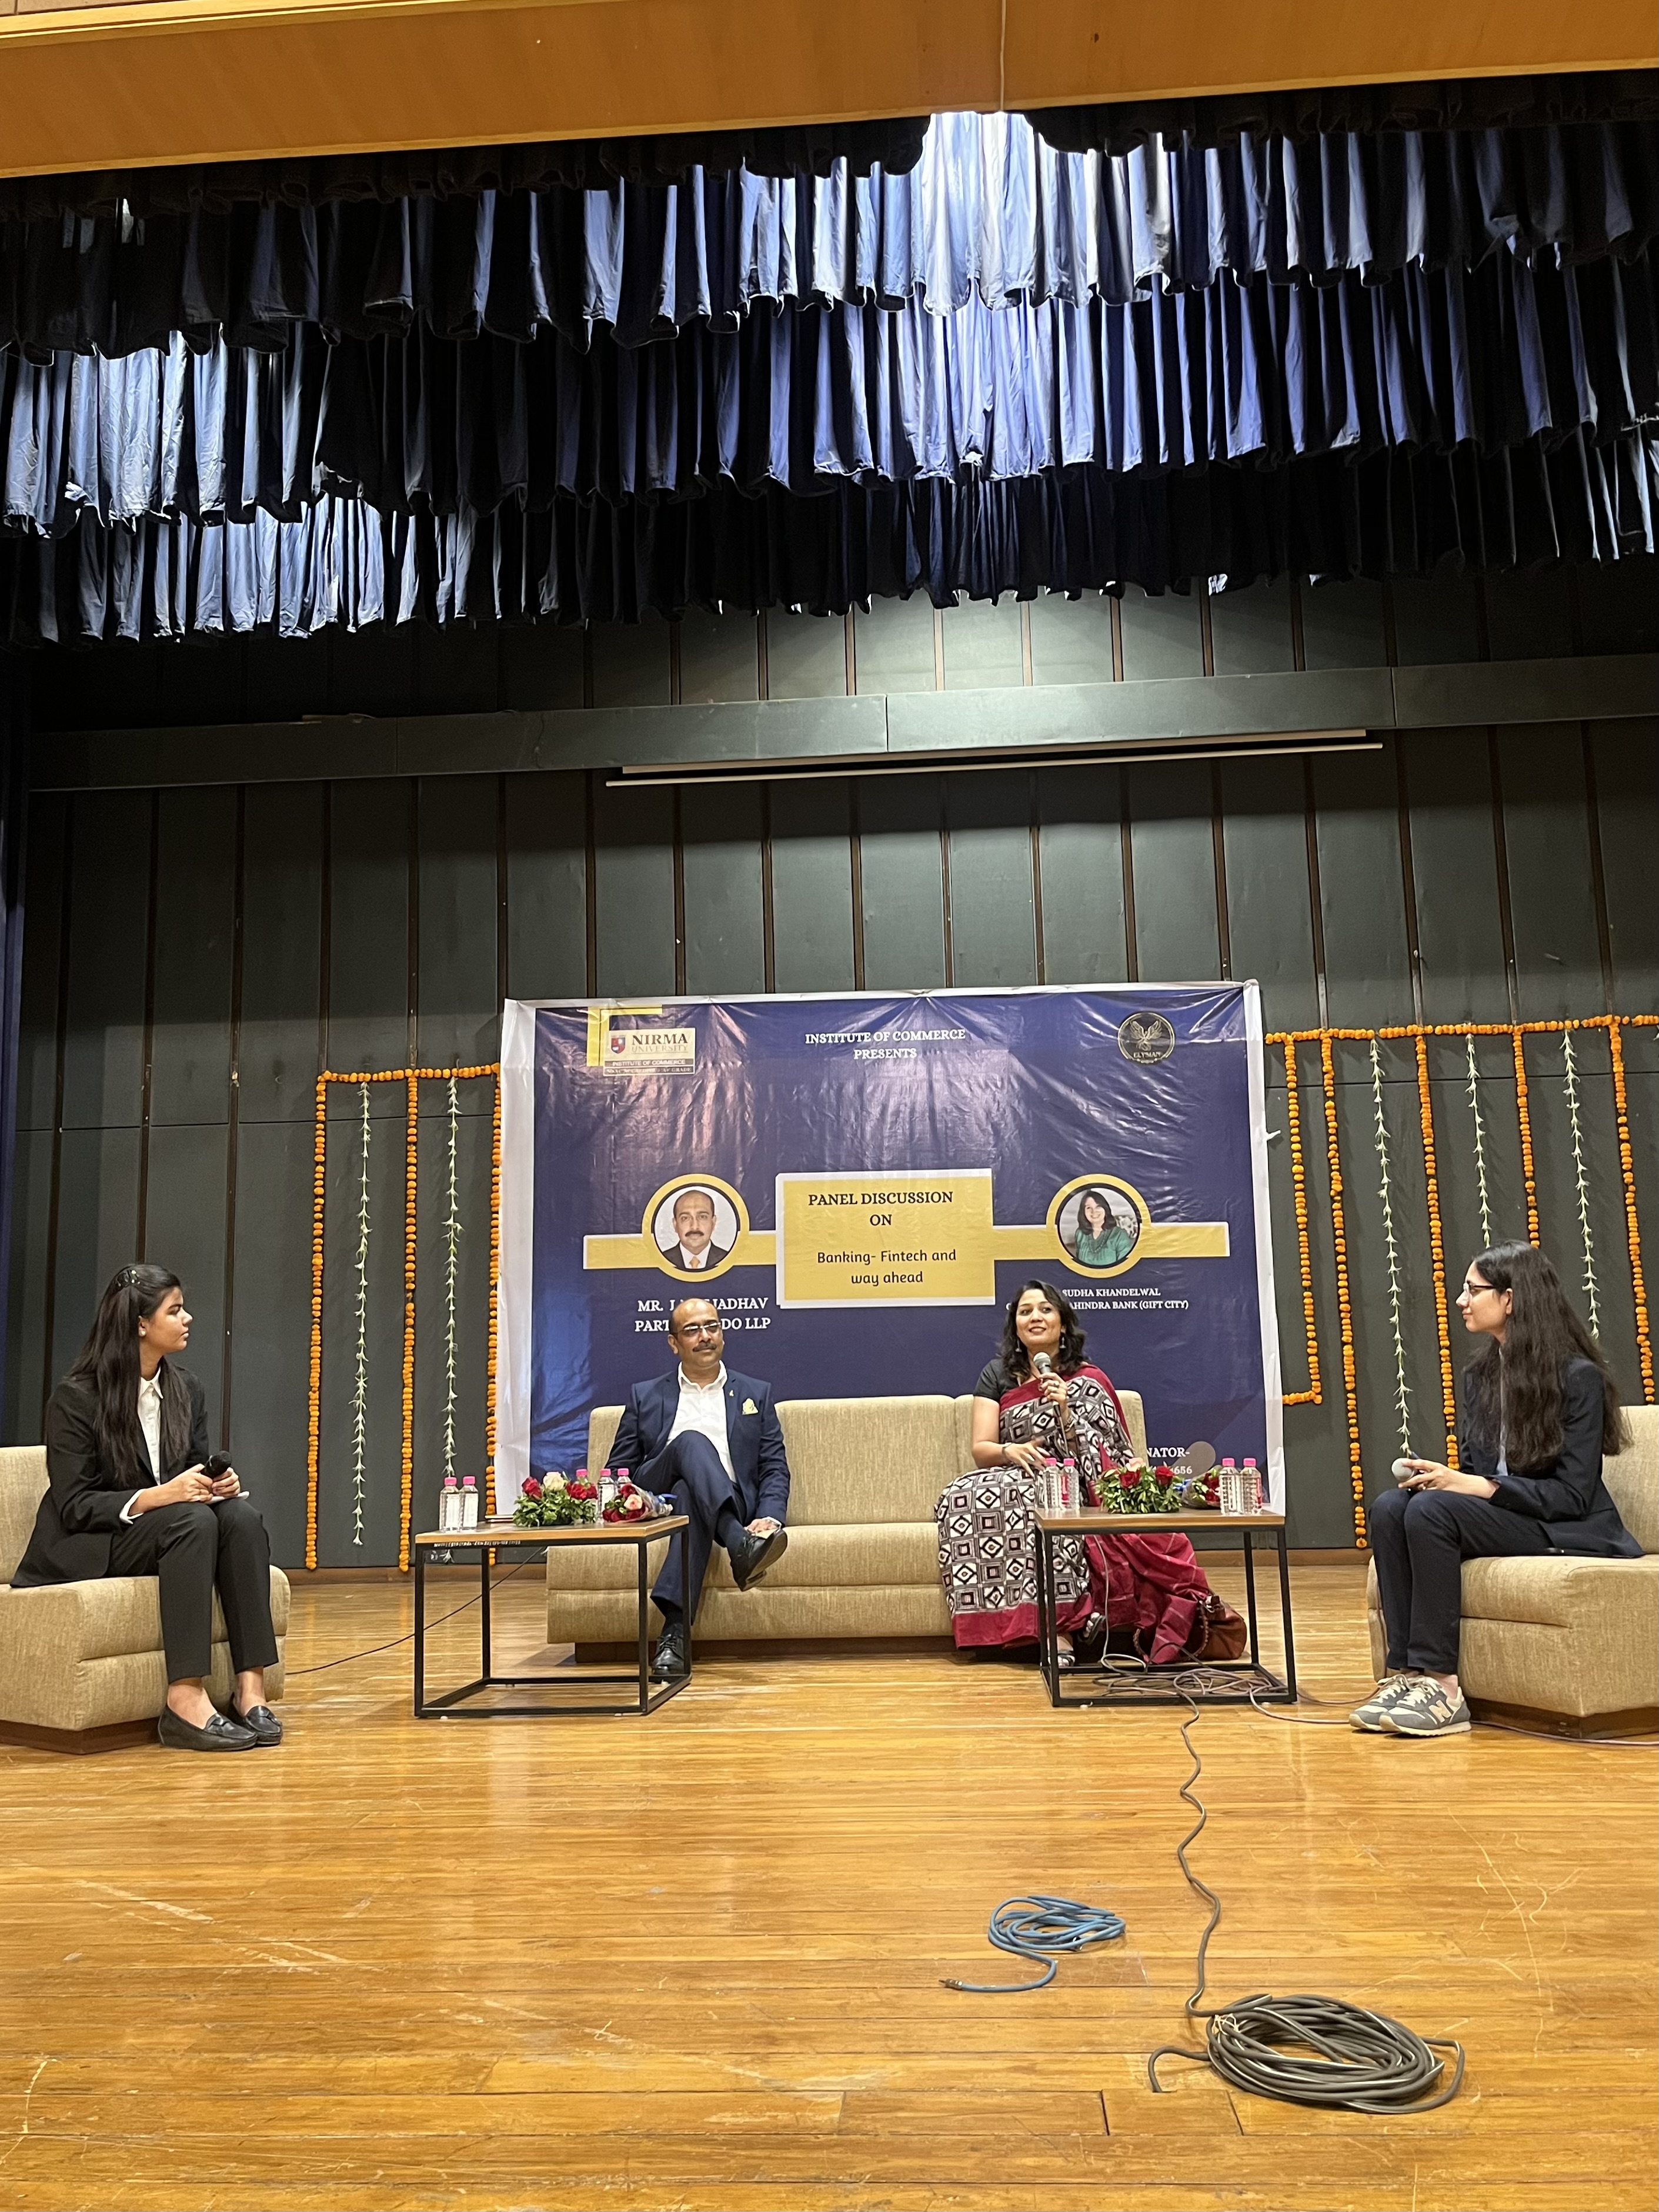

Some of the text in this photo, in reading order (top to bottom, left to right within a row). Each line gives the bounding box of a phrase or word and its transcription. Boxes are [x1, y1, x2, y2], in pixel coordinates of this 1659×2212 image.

[632, 1033, 688, 1045] NIRMA
[805, 1029, 966, 1044] INSTITUTE OF COMMERCE
[854, 1048, 917, 1059] PRESENTS
[808, 1191, 953, 1206] PANEL DISCUSSION
[870, 1214, 892, 1226] ON
[817, 1249, 956, 1265] Banking- Fintech and
[851, 1271, 923, 1287] way ahead
[1062, 1287, 1161, 1297] SUDHA KHANDELWAL
[637, 1300, 663, 1312] MR.
[1069, 1300, 1189, 1310] AHINDRA BANK (GIFT CITY)
[635, 1317, 771, 1332] PART DO LLP
[1146, 1446, 1190, 1457] NATOR-
